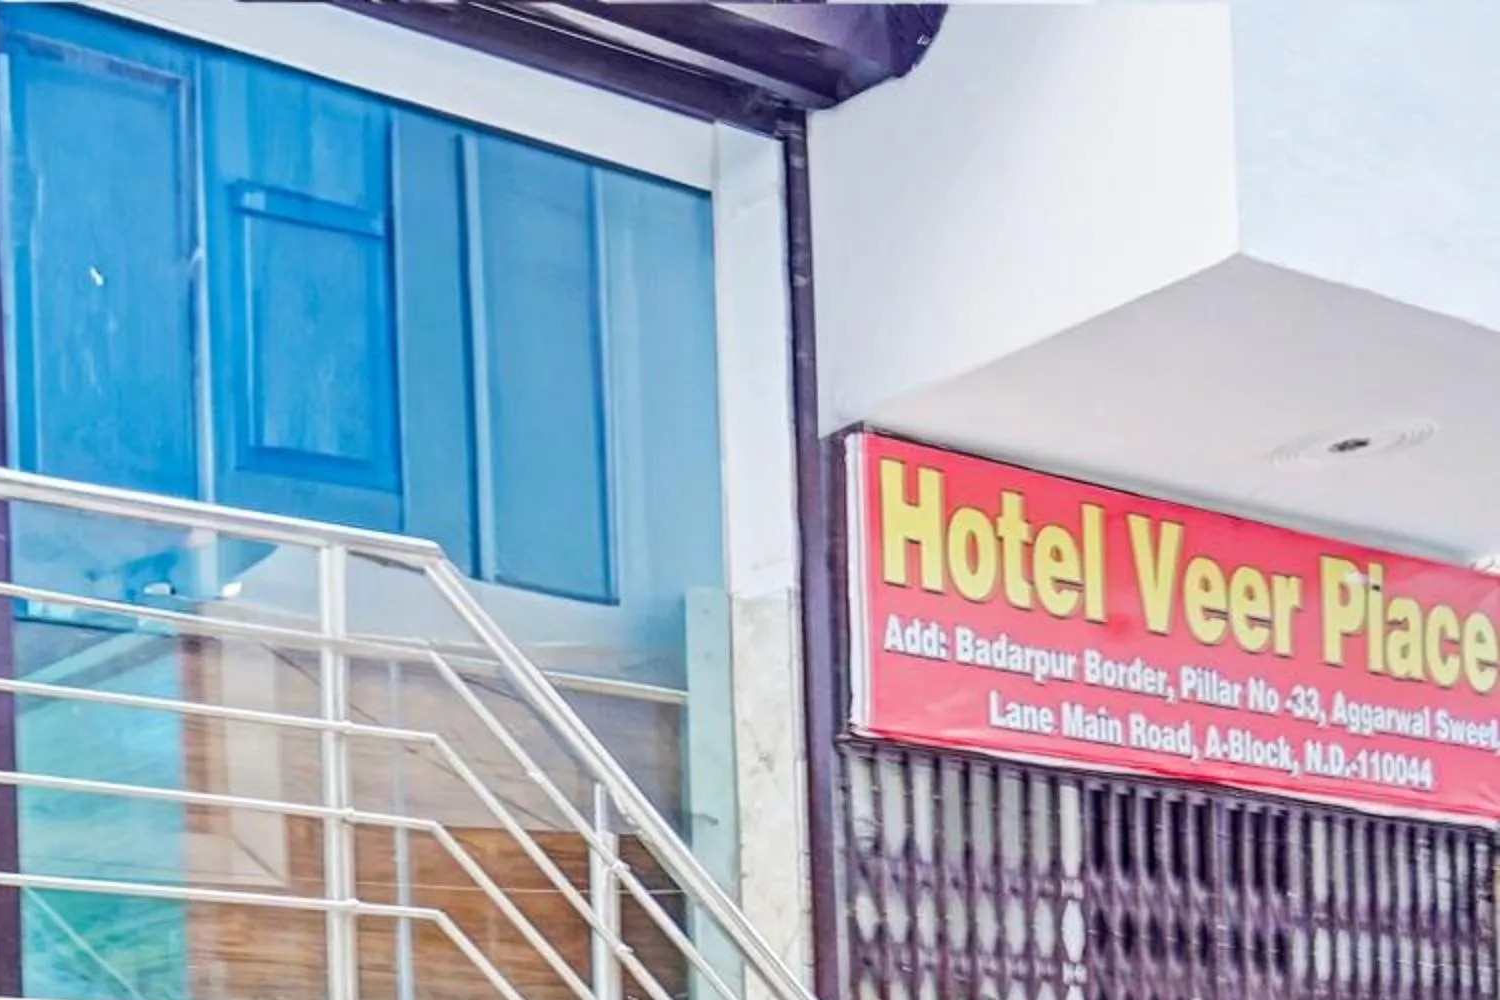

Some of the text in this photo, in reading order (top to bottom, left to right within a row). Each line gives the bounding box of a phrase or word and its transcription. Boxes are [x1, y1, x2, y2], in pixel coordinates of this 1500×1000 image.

[880, 459, 1106, 623] Hotel
[1128, 513, 1302, 655] Veer
[885, 614, 947, 658] Add:
[956, 625, 1077, 682] Badarpur
[1084, 648, 1176, 700] Border,
[1181, 666, 1242, 706] Pillar
[1332, 692, 1432, 737] Aggarwal
[990, 691, 1055, 732] Lane
[1061, 702, 1124, 744] Main
[1130, 713, 1199, 760] Road,
